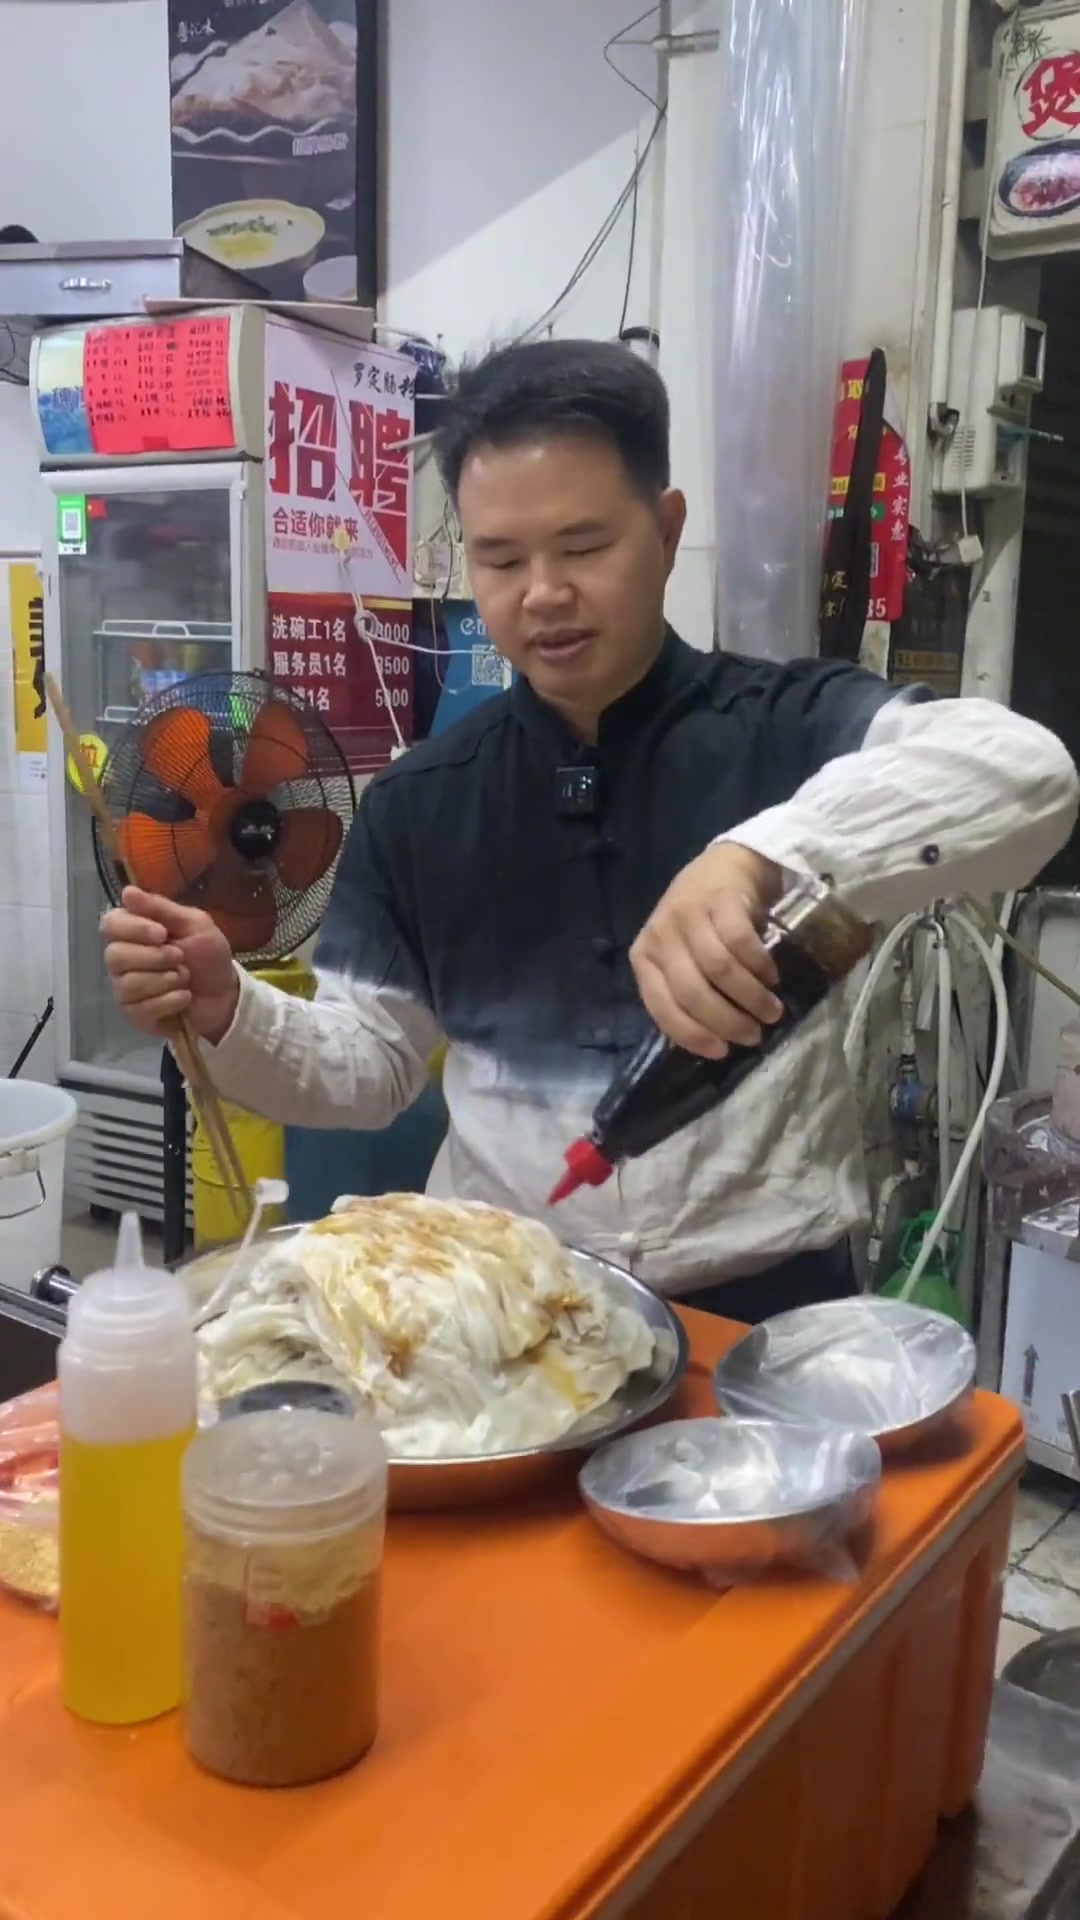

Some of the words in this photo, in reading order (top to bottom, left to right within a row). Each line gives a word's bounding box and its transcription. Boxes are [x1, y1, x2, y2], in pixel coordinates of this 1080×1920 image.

[269, 381, 410, 514] 招聘
[273, 506, 358, 541] 合适你就来
[272, 614, 347, 643] 洗碗工1名
[273, 650, 347, 677] 服务员1名
